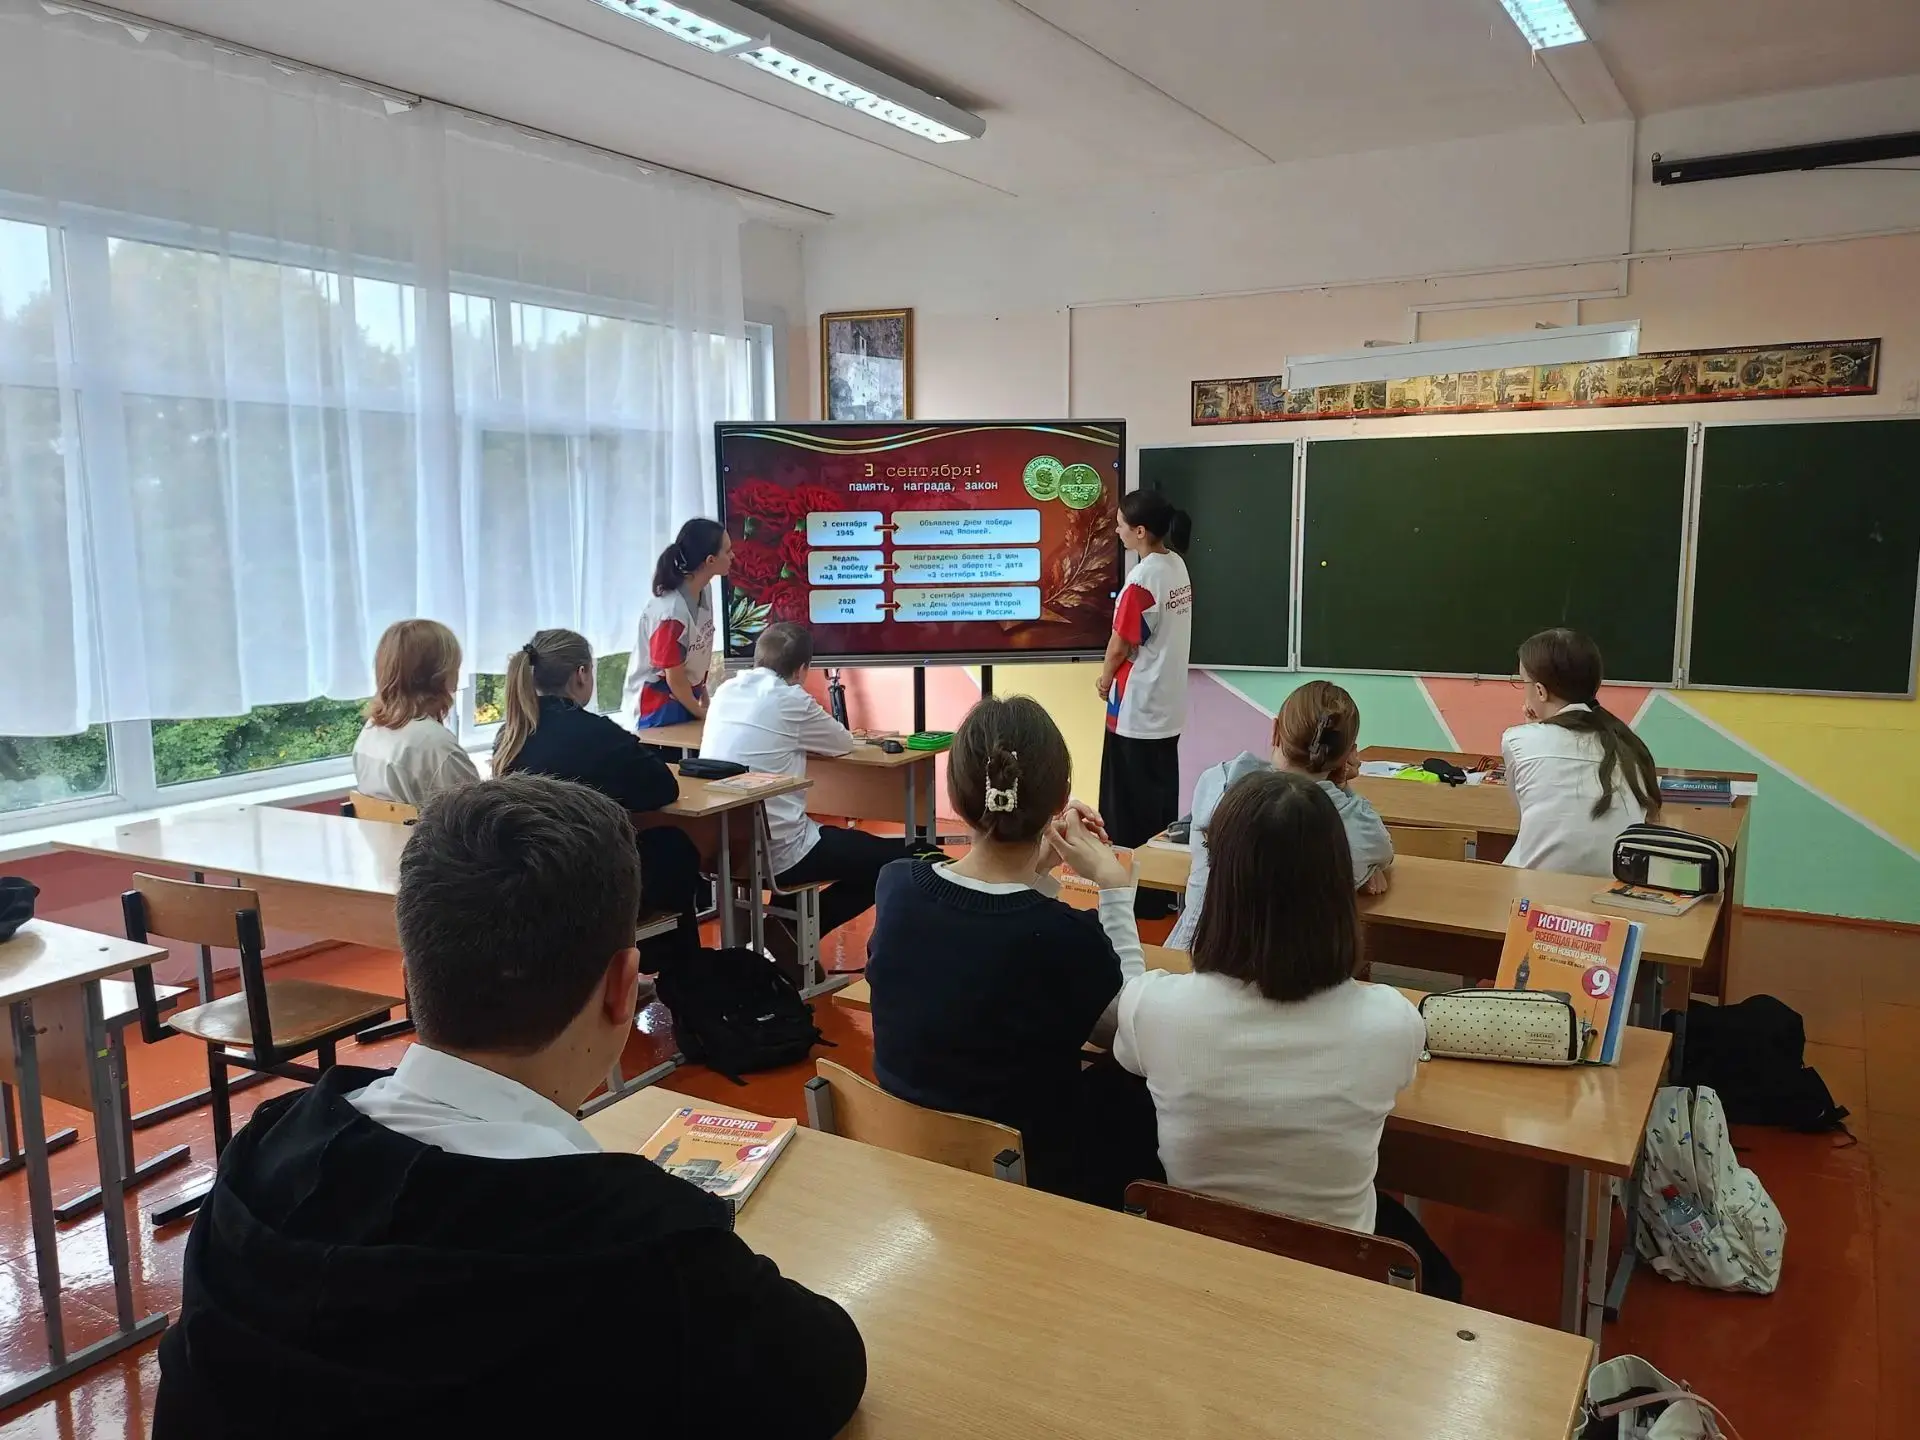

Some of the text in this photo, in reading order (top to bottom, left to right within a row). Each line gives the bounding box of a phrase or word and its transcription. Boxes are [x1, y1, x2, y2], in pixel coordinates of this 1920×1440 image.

[864, 463, 981, 480] 3 сентября:
[849, 481, 998, 493] память, награда, закон
[831, 520, 867, 529] сентября
[841, 563, 869, 572] победу
[940, 571, 976, 579] сентября
[930, 592, 964, 600] сентября
[1537, 913, 1594, 938] ИСТОРИЯ
[1534, 930, 1602, 956] ВСЕОБЩАЯ ИСТОРИЯ
[1591, 969, 1611, 995] 9
[697, 1115, 759, 1130] ИСТОРИЯ
[744, 1145, 769, 1161] 9
